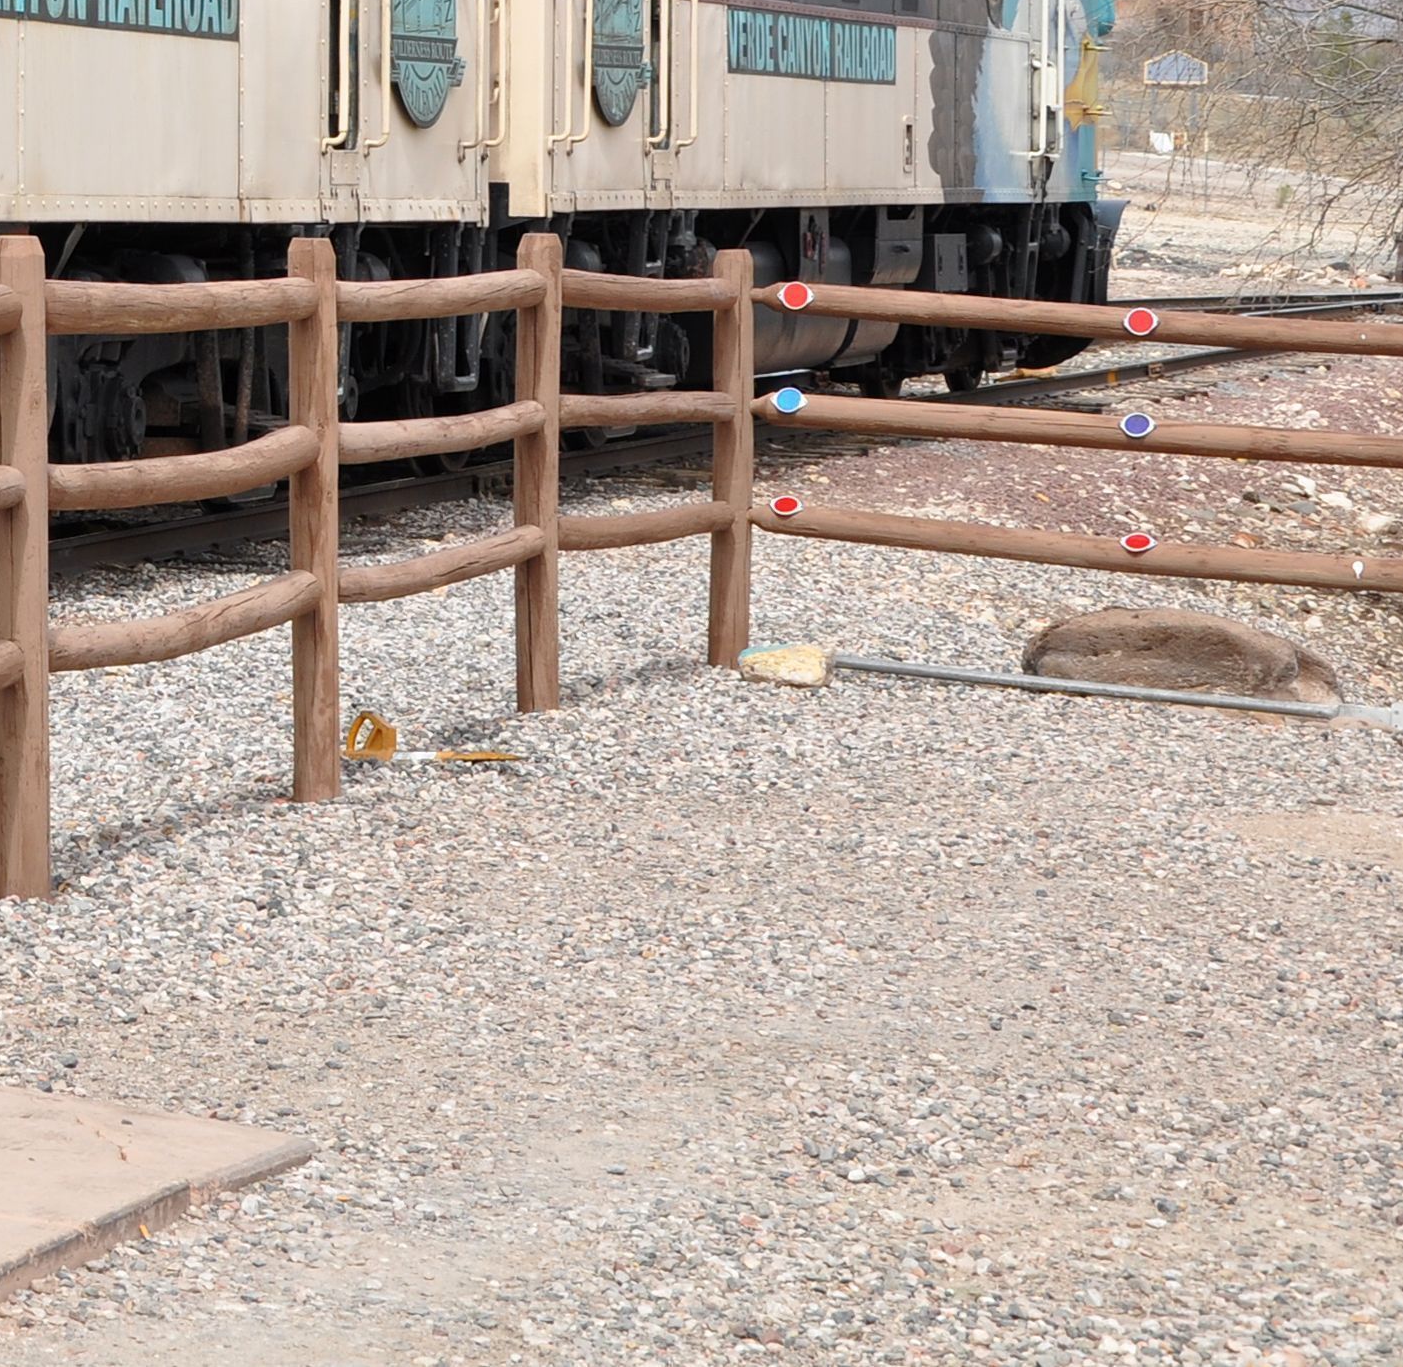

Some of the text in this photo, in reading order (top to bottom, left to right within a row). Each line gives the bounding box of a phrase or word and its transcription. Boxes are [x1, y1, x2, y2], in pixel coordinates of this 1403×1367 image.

[728, 9, 895, 82] VERDE CANYON RAILROAD
